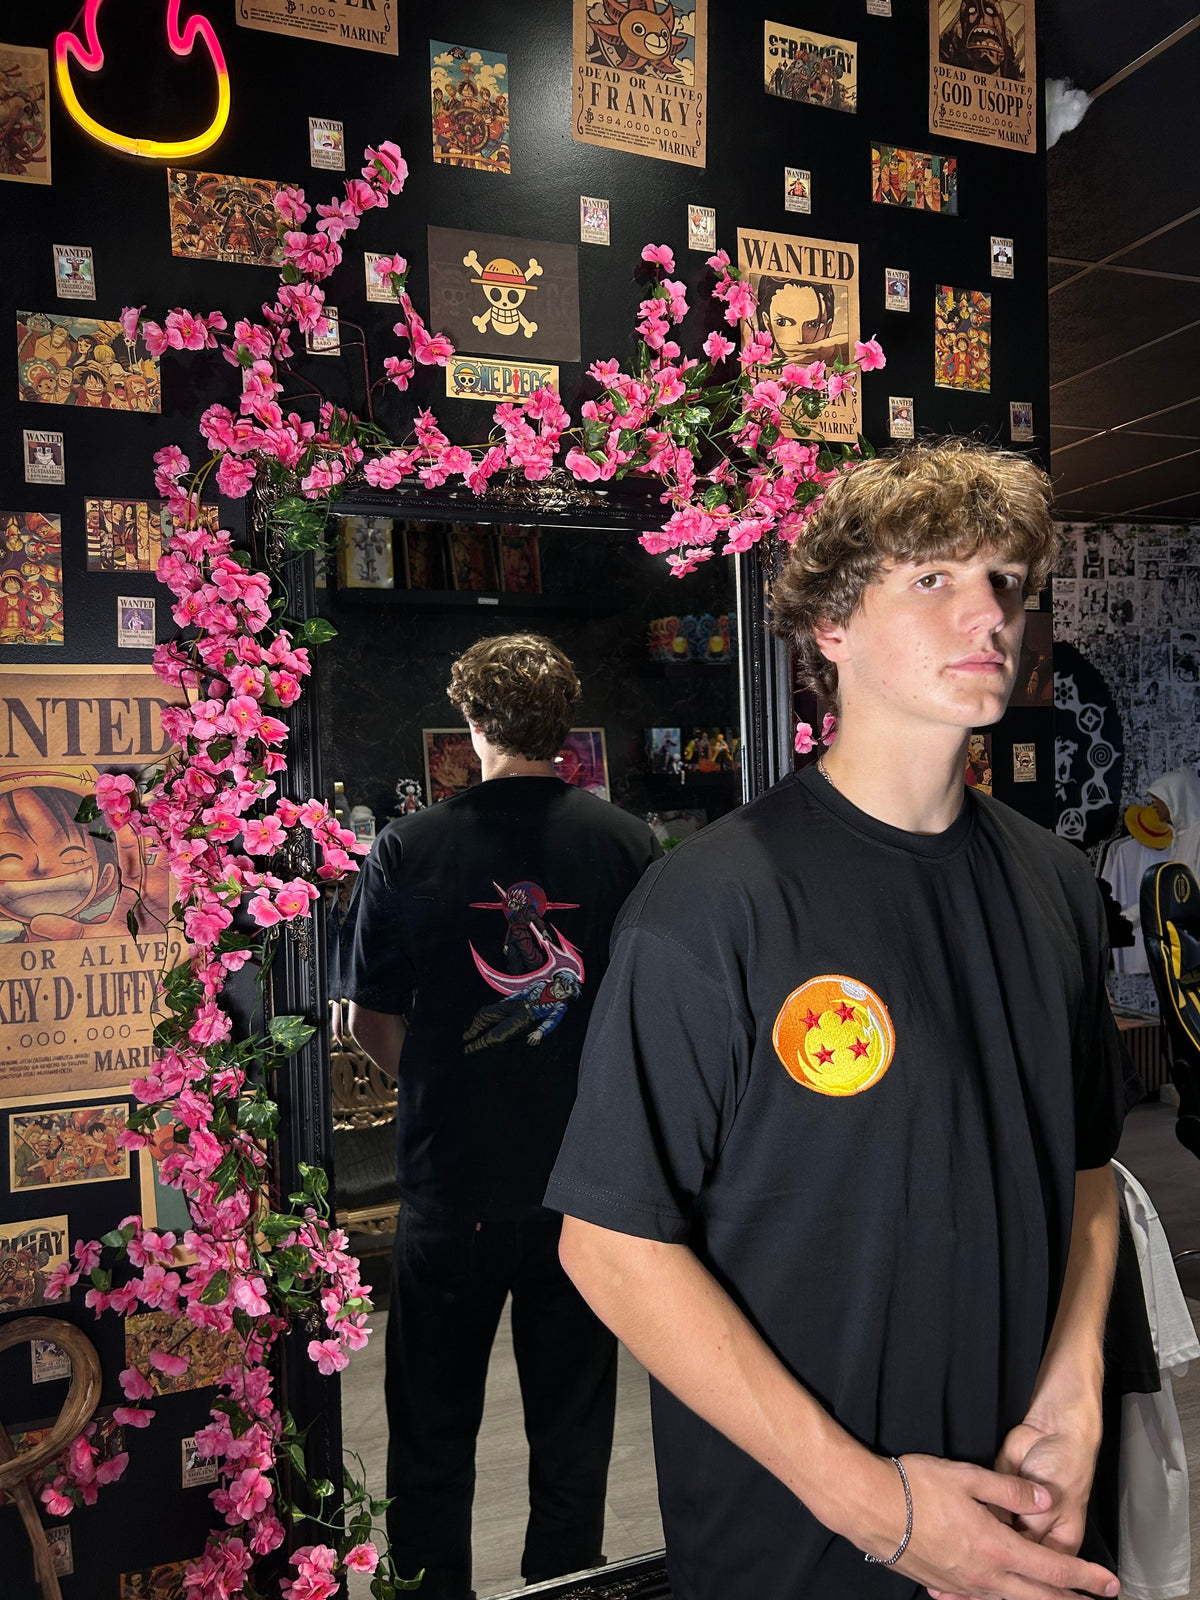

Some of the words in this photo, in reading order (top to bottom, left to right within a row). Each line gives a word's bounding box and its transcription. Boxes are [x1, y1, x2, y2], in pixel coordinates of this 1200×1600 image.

[340, 23, 387, 46] MARINE
[585, 66, 620, 84] DEAD
[629, 76, 646, 90] OR
[655, 83, 696, 101] ALIVE
[939, 66, 967, 82] DEAD
[973, 74, 987, 87] OR
[994, 80, 1027, 95] ALIVE
[590, 81, 690, 127] FRANKY
[941, 80, 972, 107] GOD
[978, 88, 1024, 118] USOPP
[311, 120, 343, 131] WANTED
[998, 128, 1030, 146] MARINE
[659, 138, 698, 159] MARINE
[786, 169, 810, 180] WANTED
[582, 198, 609, 210] WANTED
[690, 206, 715, 218] WANTED
[991, 238, 1013, 248] WANTED
[55, 247, 92, 258] WANTED
[741, 236, 855, 281] WANTED
[887, 270, 909, 280] WANTED
[890, 398, 913, 407] WANTED
[819, 421, 855, 435] MARINE
[26, 432, 63, 443] WANTED
[120, 599, 155, 609] WANTED
[0, 697, 175, 758] NTED
[20, 949, 57, 972] OR
[79, 942, 167, 968] ALIVE
[94, 1045, 161, 1073] MARIN
